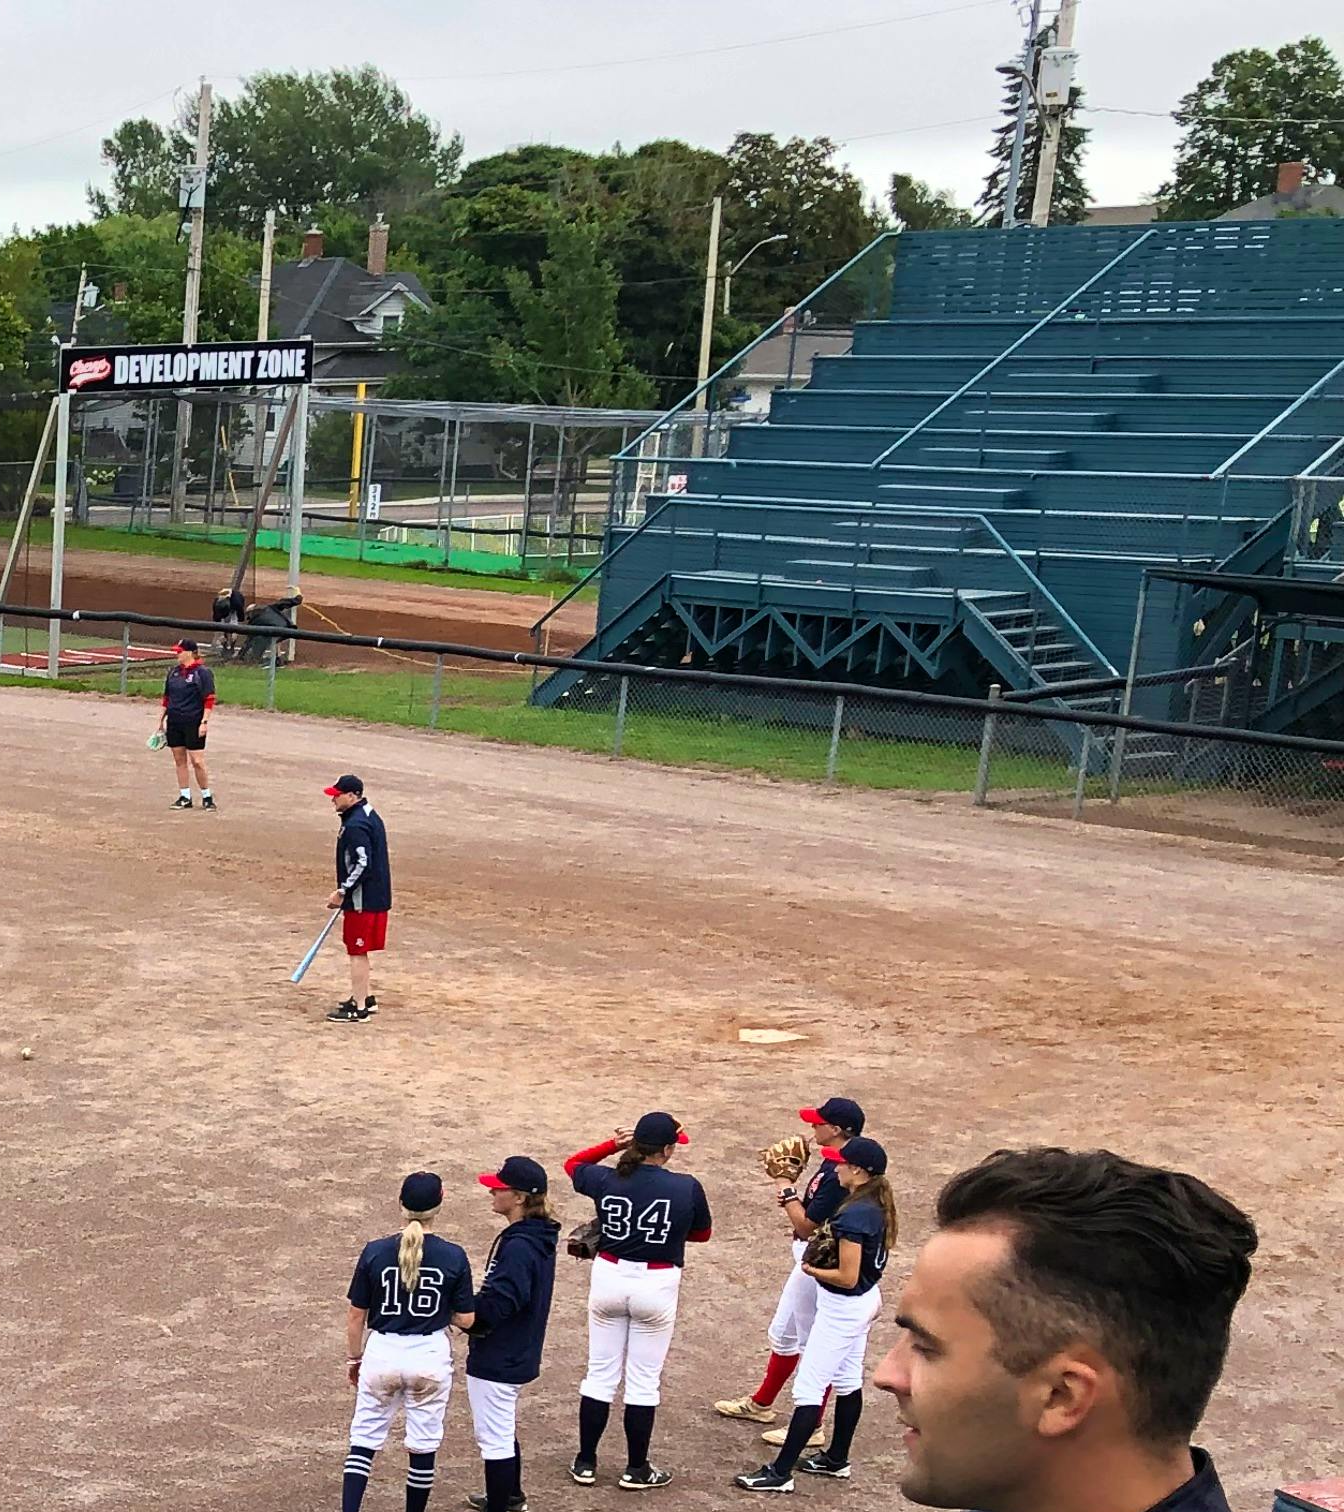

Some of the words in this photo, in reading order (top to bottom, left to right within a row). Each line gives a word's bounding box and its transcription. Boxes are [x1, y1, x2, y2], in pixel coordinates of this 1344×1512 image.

[113, 351, 254, 385] DEVELOPMENT
[256, 349, 306, 379] ZONE
[601, 1195, 672, 1244] 34
[380, 1266, 444, 1317] 16
